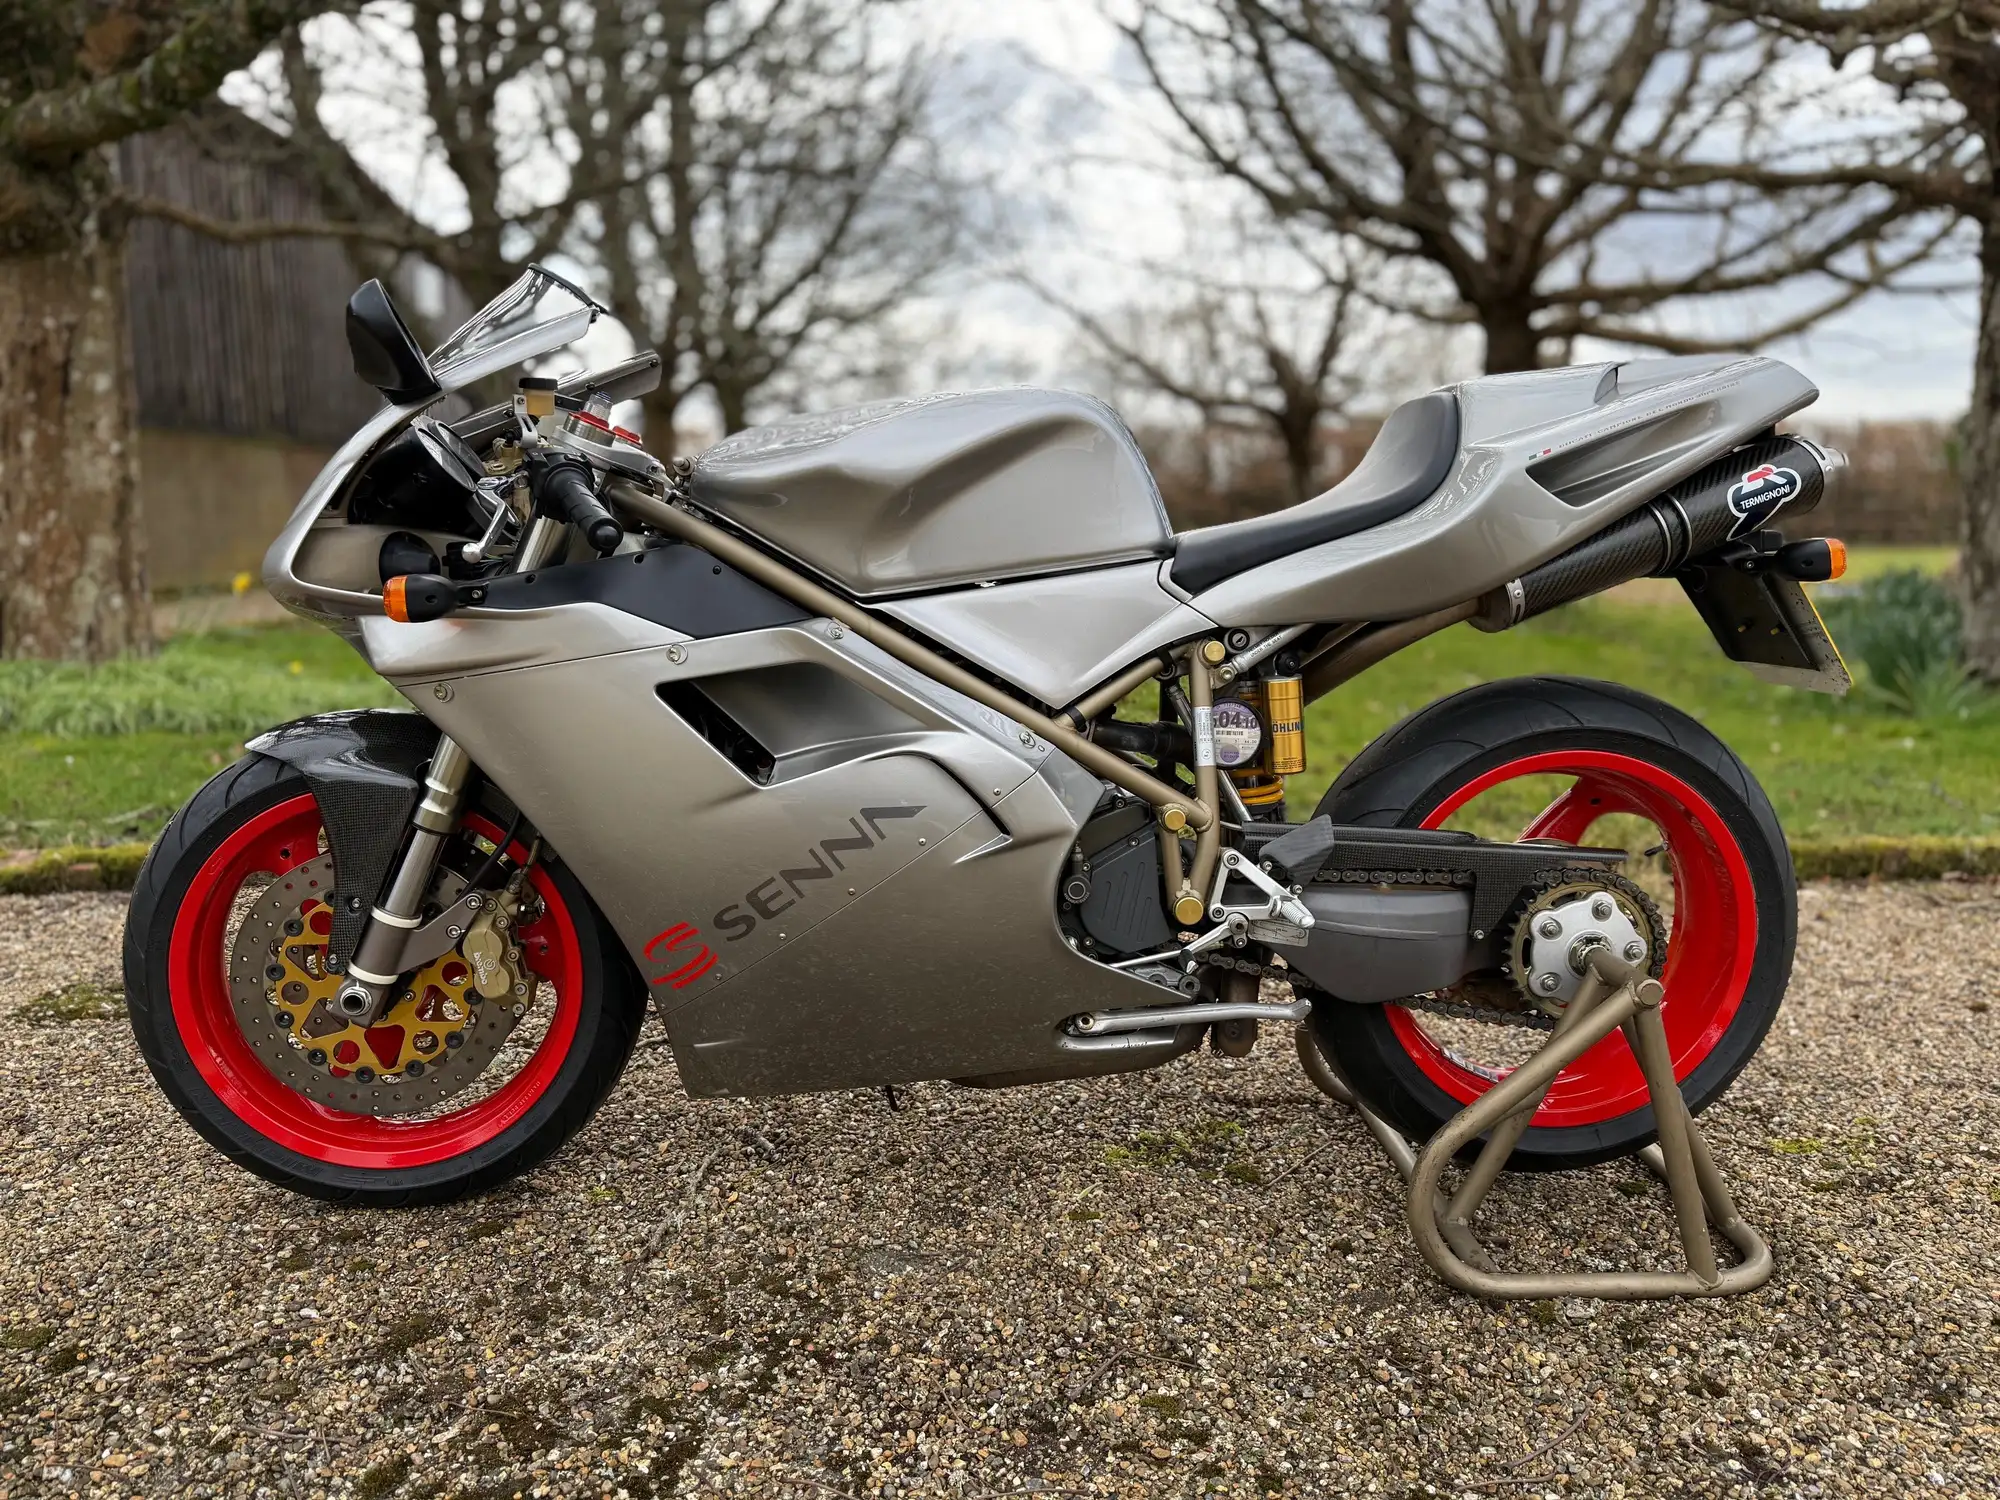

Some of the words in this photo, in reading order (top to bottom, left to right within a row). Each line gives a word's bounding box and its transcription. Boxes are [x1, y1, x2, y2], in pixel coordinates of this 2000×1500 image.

[1740, 484, 1791, 509] TERMIGNONI
[712, 805, 928, 942] SENNA
[473, 952, 488, 985] brembo
